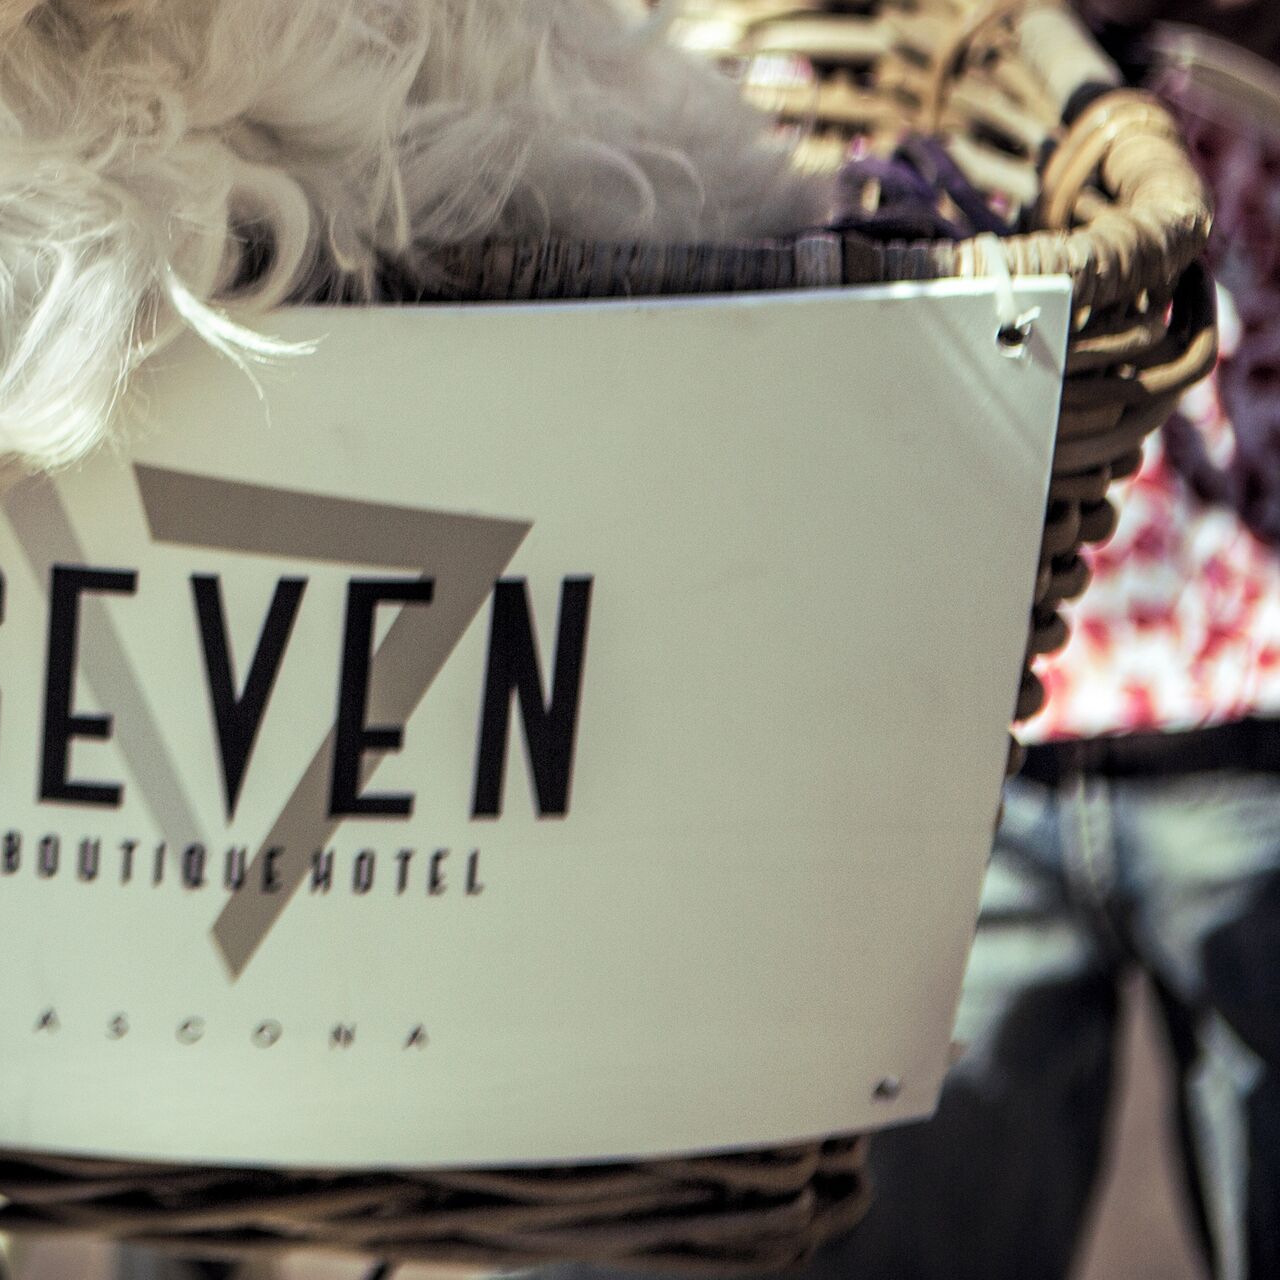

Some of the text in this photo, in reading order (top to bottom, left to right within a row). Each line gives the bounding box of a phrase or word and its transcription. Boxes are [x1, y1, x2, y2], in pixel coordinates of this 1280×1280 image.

[1, 831, 485, 897] BOUTIQUE HOTEL
[35, 1008, 429, 1051] ASCONA
